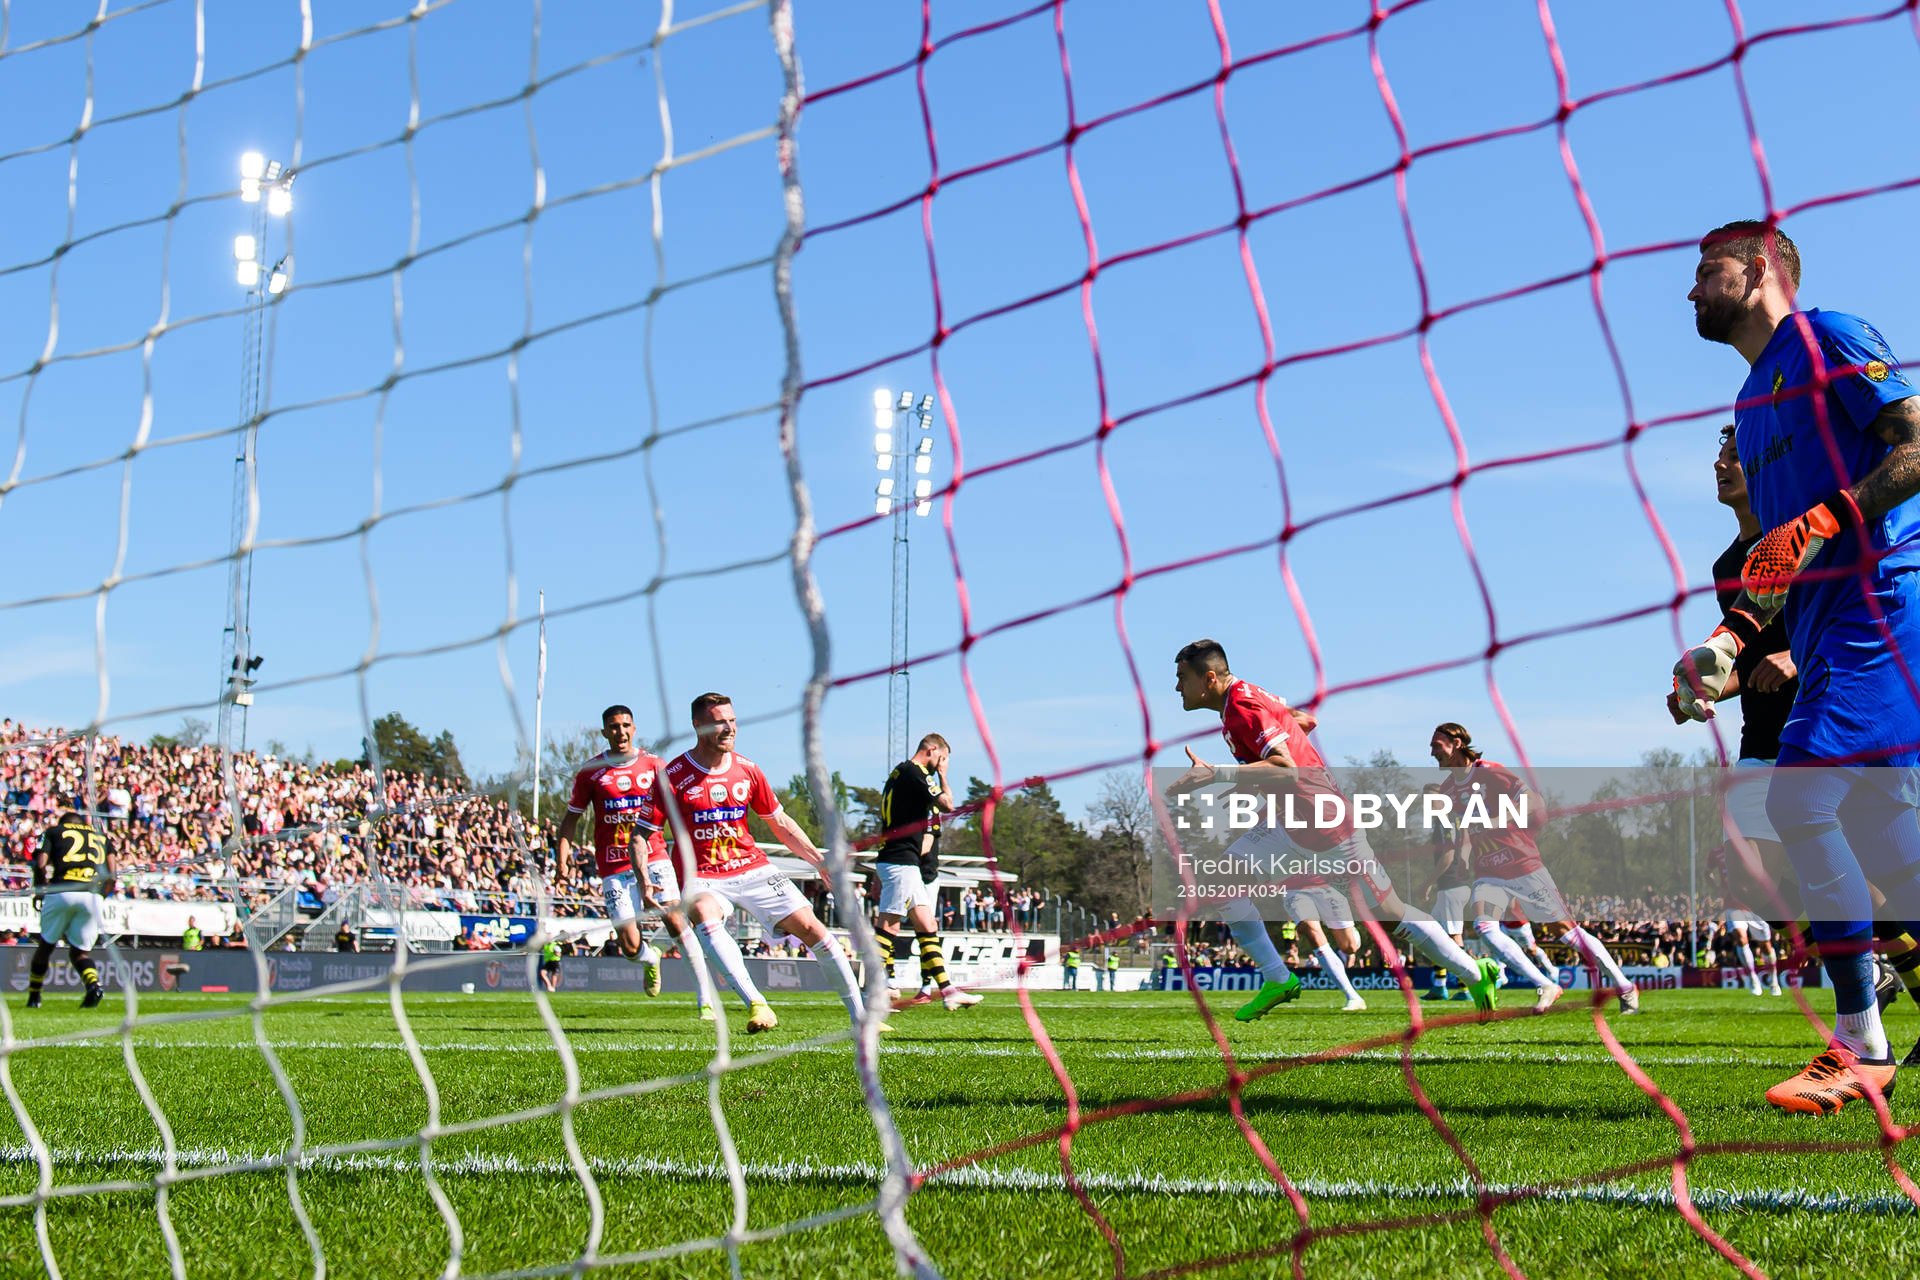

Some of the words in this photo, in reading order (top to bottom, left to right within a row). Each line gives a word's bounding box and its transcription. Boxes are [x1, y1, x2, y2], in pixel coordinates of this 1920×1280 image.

[605, 796, 645, 809] Helmi
[694, 821, 738, 840] askås
[62, 829, 106, 864] 25
[609, 848, 629, 860] STY
[43, 960, 154, 990] DEGRFORS
[1165, 968, 1261, 991] Helmi
[1300, 971, 1338, 989] skås
[1352, 970, 1400, 990] askås
[1582, 968, 1677, 990] Thrmia
